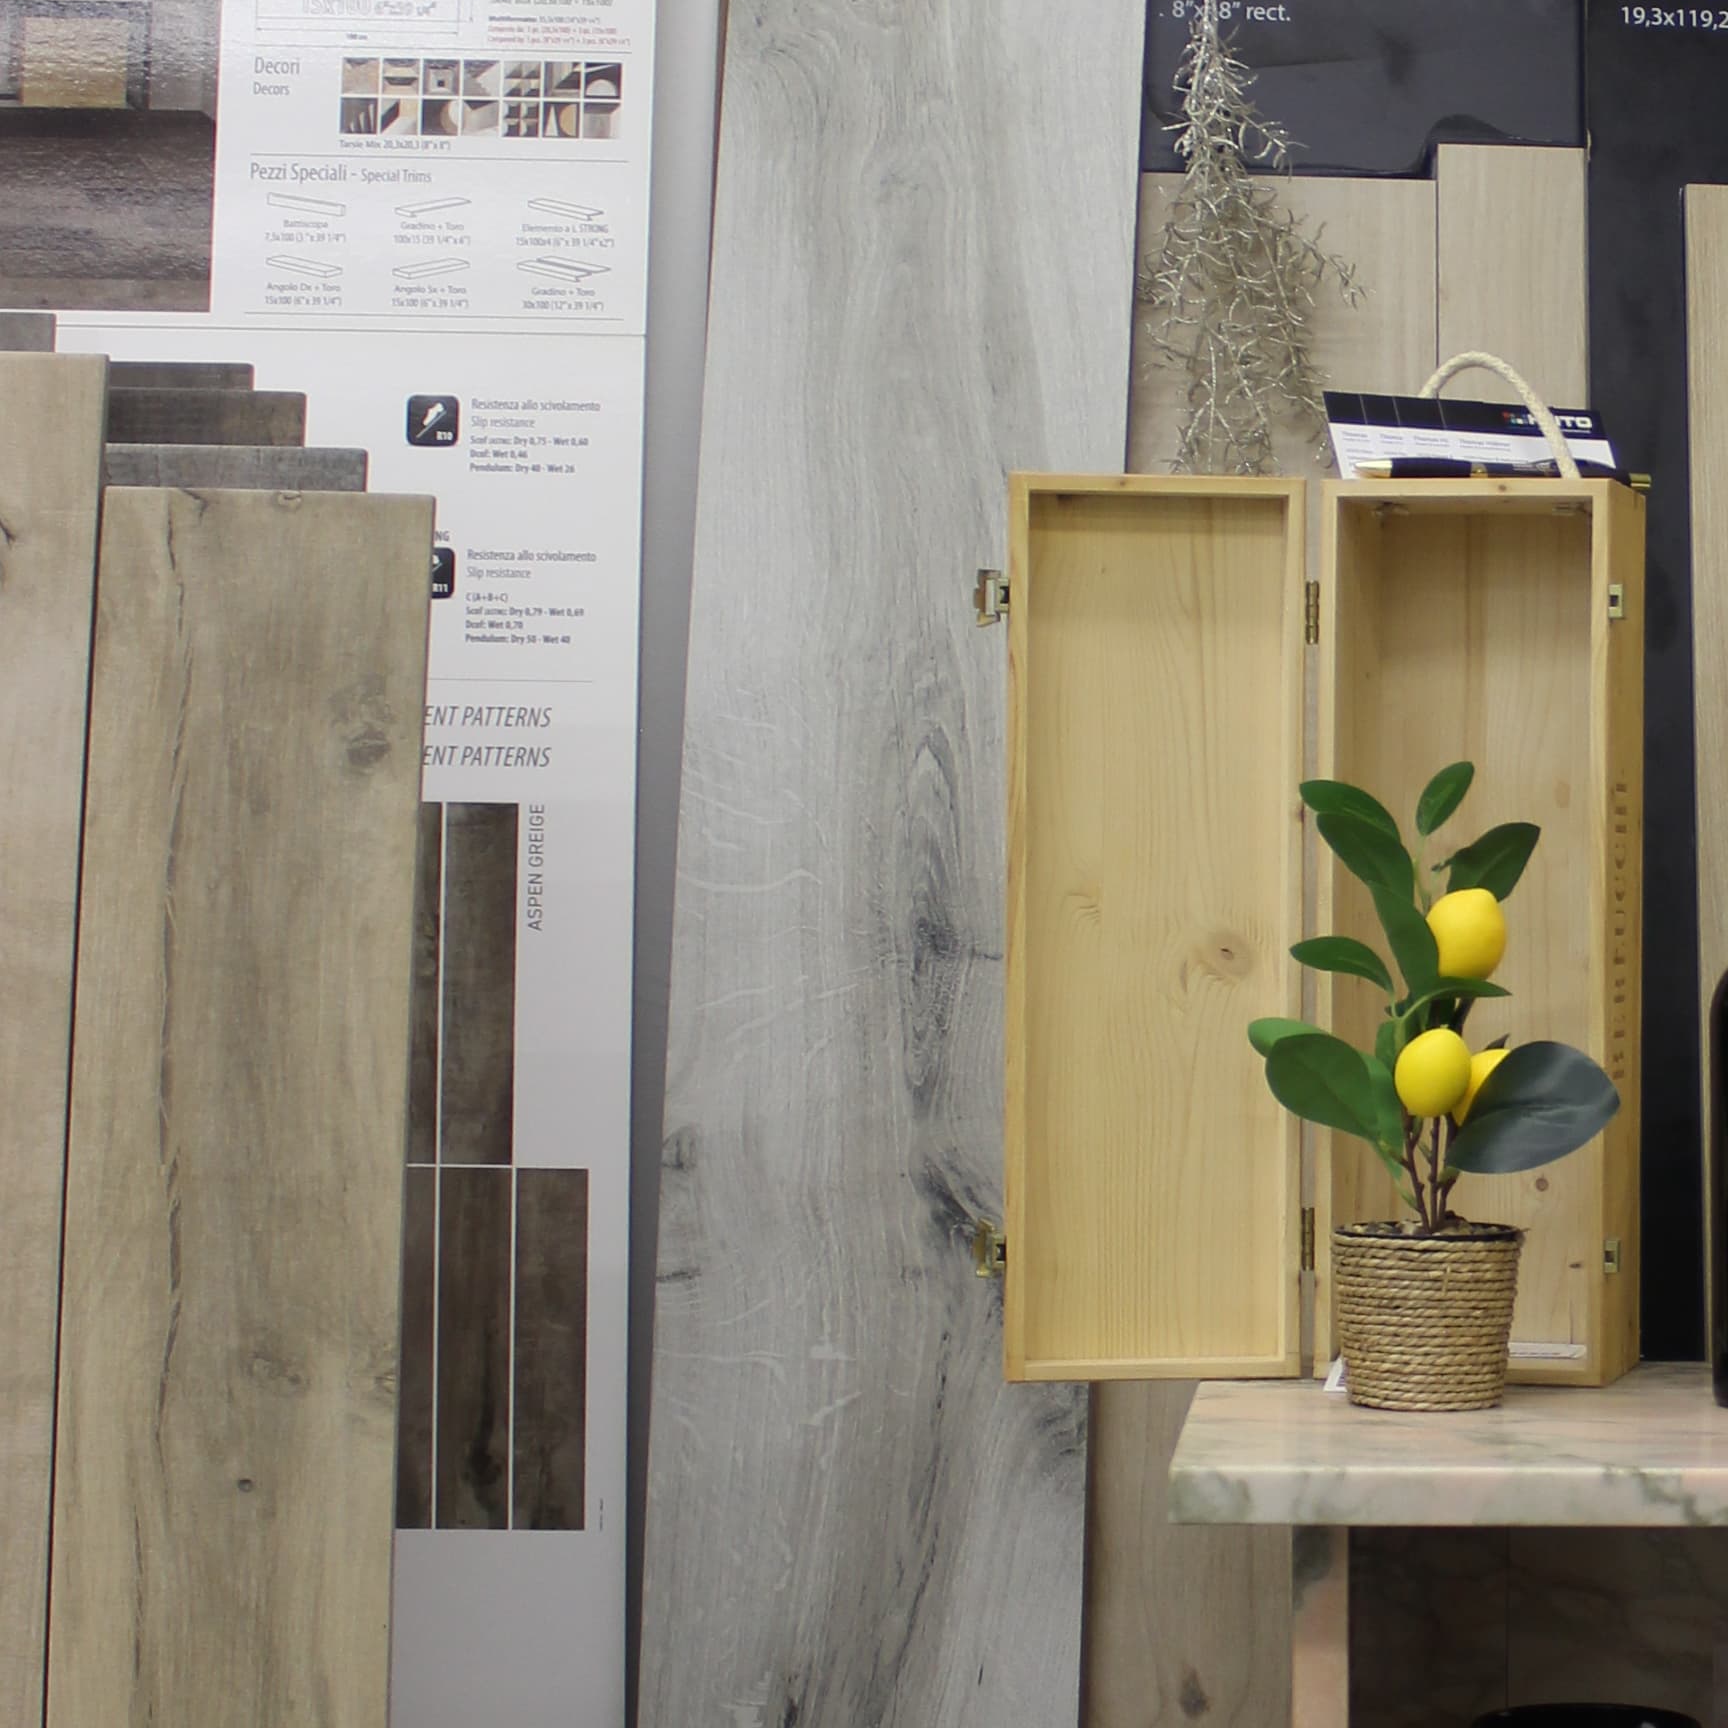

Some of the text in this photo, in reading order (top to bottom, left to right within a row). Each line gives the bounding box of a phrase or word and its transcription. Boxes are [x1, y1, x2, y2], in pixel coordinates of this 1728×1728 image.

[1246, 4, 1291, 22] rect.
[254, 56, 300, 75] Decori
[253, 82, 290, 96] Decors
[250, 162, 432, 184] Pezzi Speciali Special Trims
[471, 398, 601, 411] Resistenza allo scivolamento
[471, 416, 535, 429] Slip resistance
[467, 549, 597, 562] Resistenza allo scivolamento
[467, 567, 531, 579] Slip resistance
[461, 706, 553, 728] PATTERNS
[460, 746, 552, 768] PATTERNS
[527, 804, 545, 932] ASPEN GREIGE
